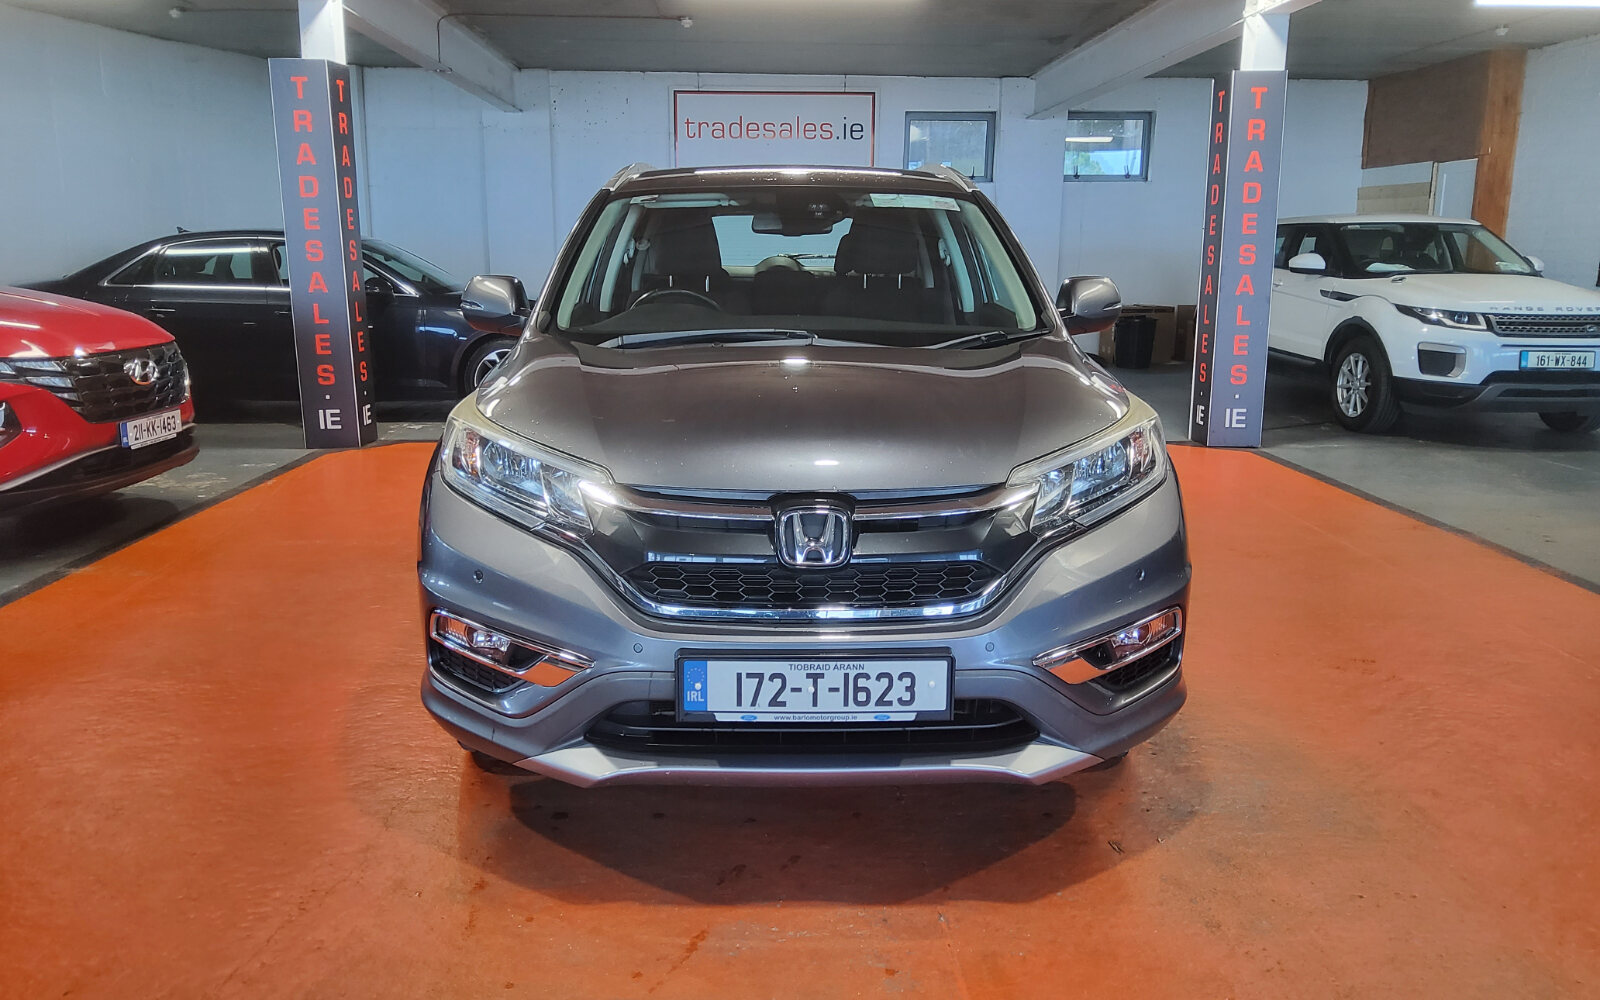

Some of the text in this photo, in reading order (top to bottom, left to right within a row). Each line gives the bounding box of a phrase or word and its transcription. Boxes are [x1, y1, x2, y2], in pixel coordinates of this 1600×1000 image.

[684, 115, 864, 140] tradesales.ie
[1536, 355, 1587, 367] 161-WX-844
[133, 415, 177, 441] 211-KK-1463
[788, 663, 831, 671] TIOBRAID
[687, 690, 704, 702] IRL
[735, 671, 917, 708] 172-T-1623
